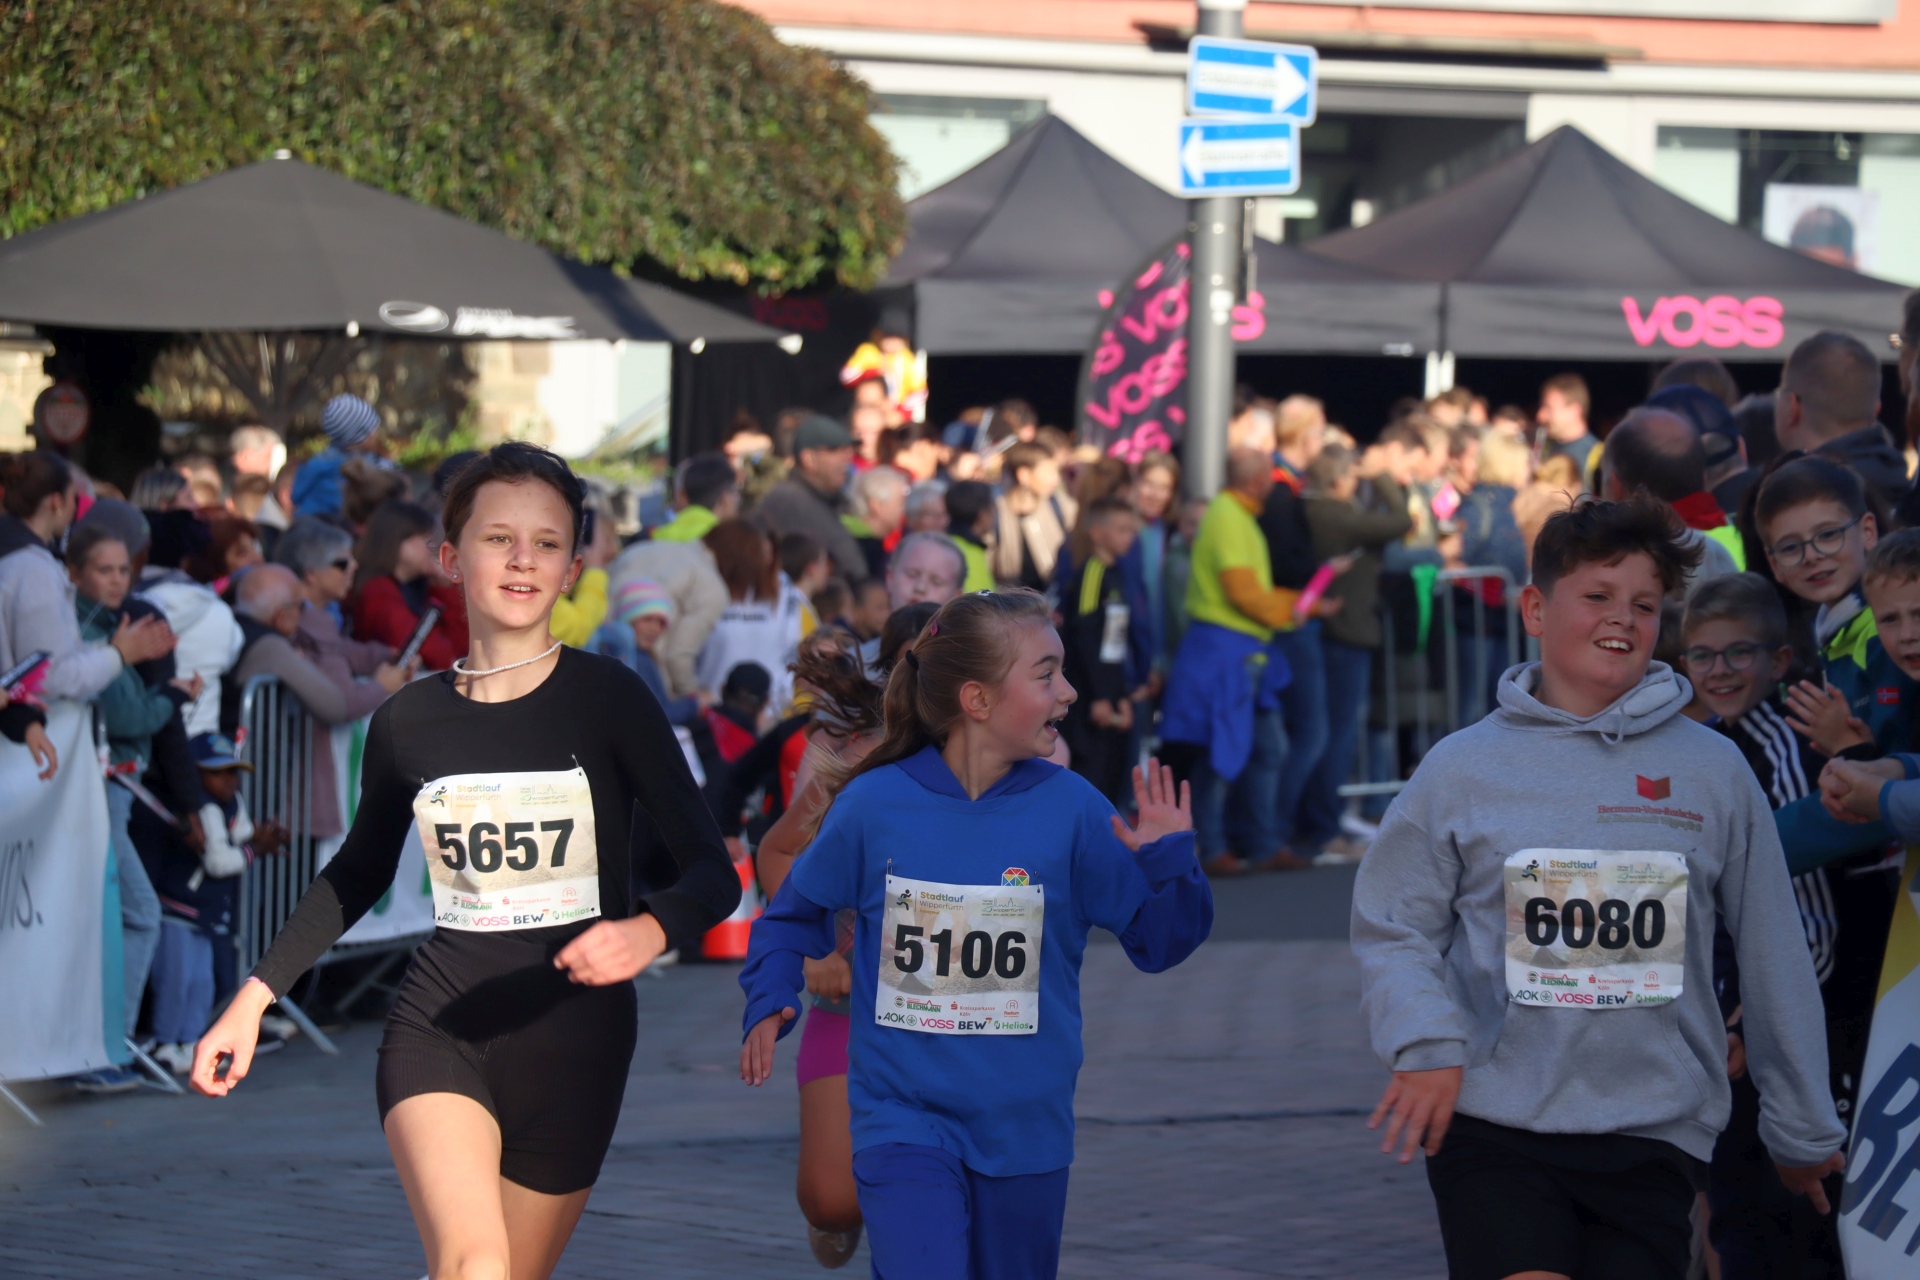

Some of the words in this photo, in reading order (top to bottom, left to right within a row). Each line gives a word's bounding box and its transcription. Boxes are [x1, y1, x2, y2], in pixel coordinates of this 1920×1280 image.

[1621, 295, 1784, 348] VOSS
[456, 783, 501, 792] Stadtlauf
[434, 818, 574, 873] 5657
[1549, 860, 1598, 869] Stadtlauf
[1549, 870, 1598, 879] Wipperfürth
[920, 891, 964, 903] Stadtlauf
[919, 900, 964, 912] Wipperfürth
[442, 912, 459, 924] AOK
[513, 913, 545, 925] BEW
[561, 907, 590, 919] Helios
[472, 915, 510, 927] VOSS
[1525, 897, 1666, 949] 6080
[893, 923, 1026, 979] 5106
[1514, 990, 1539, 1001] AOK
[1554, 993, 1594, 1005] VOSS
[1597, 995, 1628, 1005] BEW
[906, 1004, 941, 1013] BLECHMANN
[883, 1012, 905, 1024] AOK
[919, 1017, 955, 1030] VOSS
[958, 1020, 987, 1030] BEW
[1002, 1021, 1029, 1030] Helios
